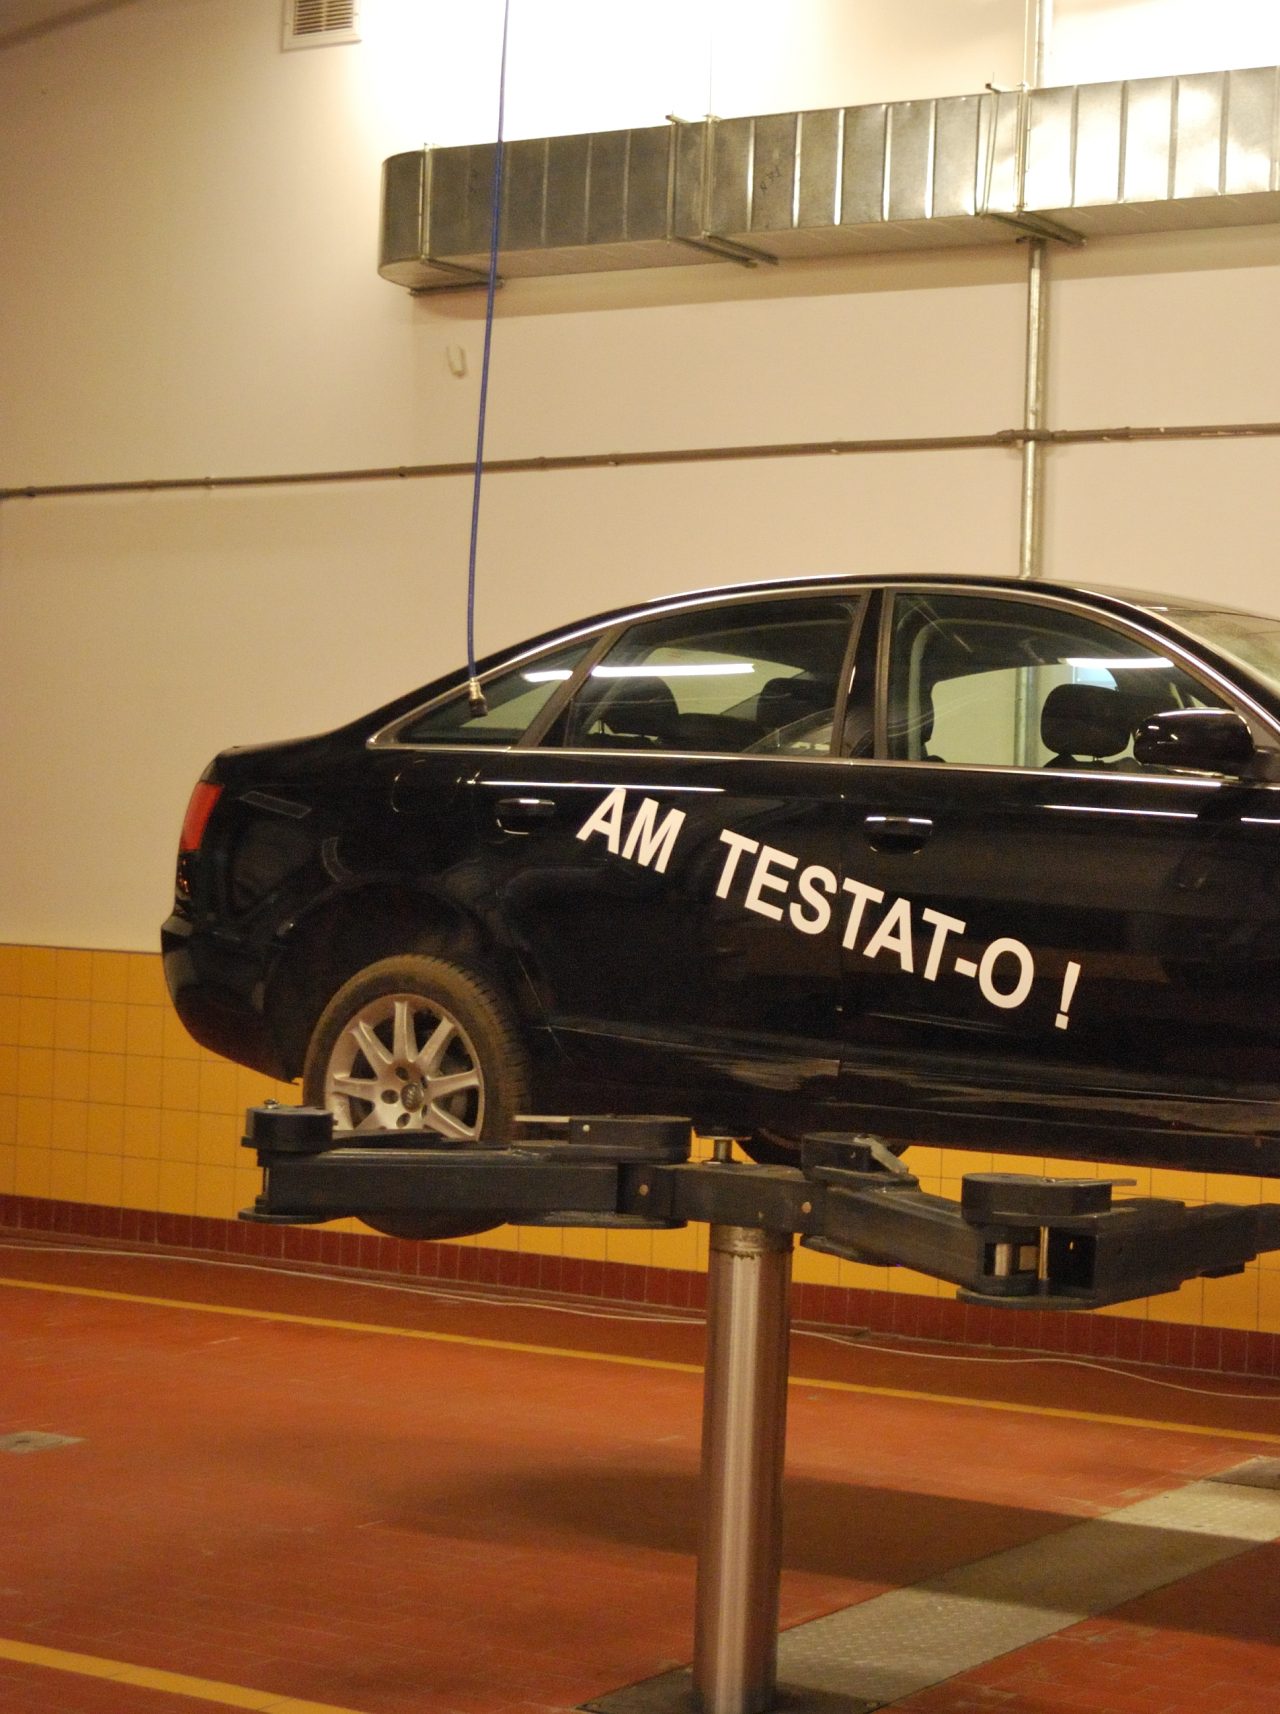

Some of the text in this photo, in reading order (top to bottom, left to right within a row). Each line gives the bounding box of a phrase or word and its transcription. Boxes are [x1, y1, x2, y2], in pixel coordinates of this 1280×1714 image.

[576, 788, 1081, 1030] AM TESTAT-O !
